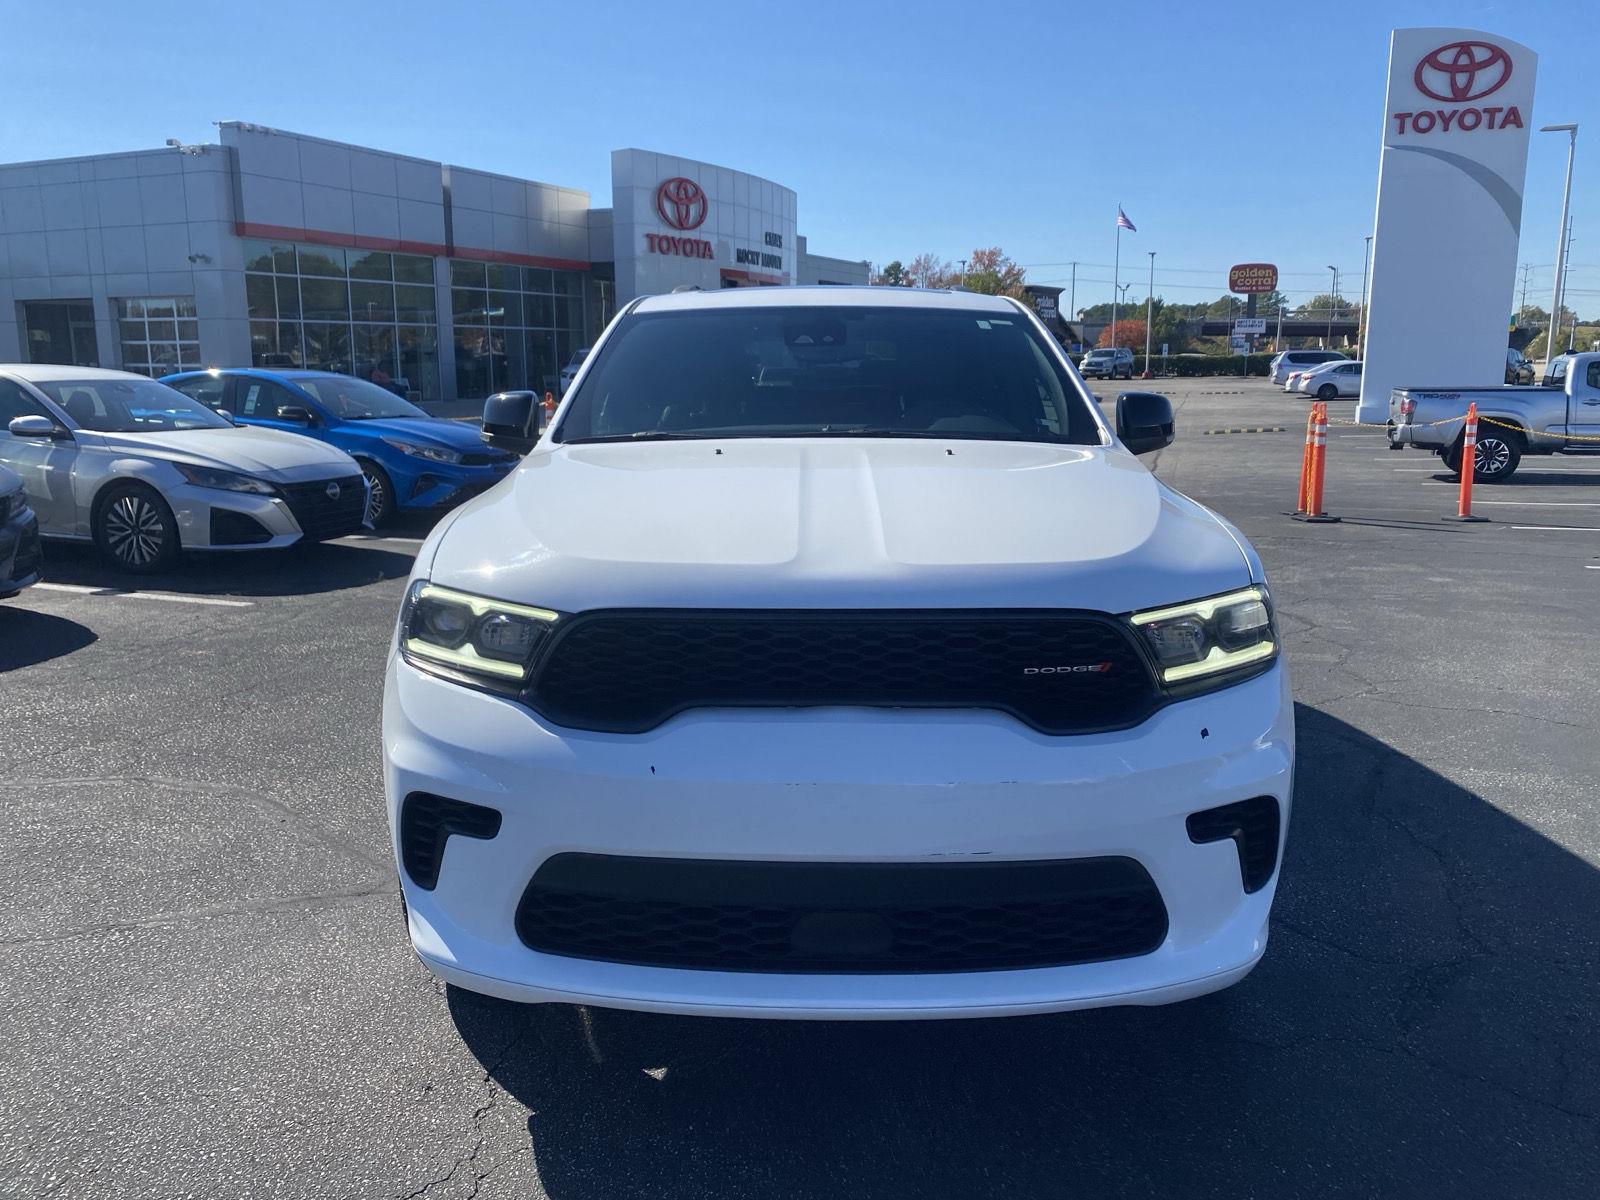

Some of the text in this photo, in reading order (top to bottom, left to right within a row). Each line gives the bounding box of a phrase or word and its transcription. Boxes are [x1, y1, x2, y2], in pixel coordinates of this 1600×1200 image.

[1393, 106, 1524, 135] TOYOTA
[645, 233, 715, 260] TOYOTA
[1231, 268, 1273, 279] golden
[1237, 276, 1276, 285] corral
[1024, 665, 1102, 675] DODGE
